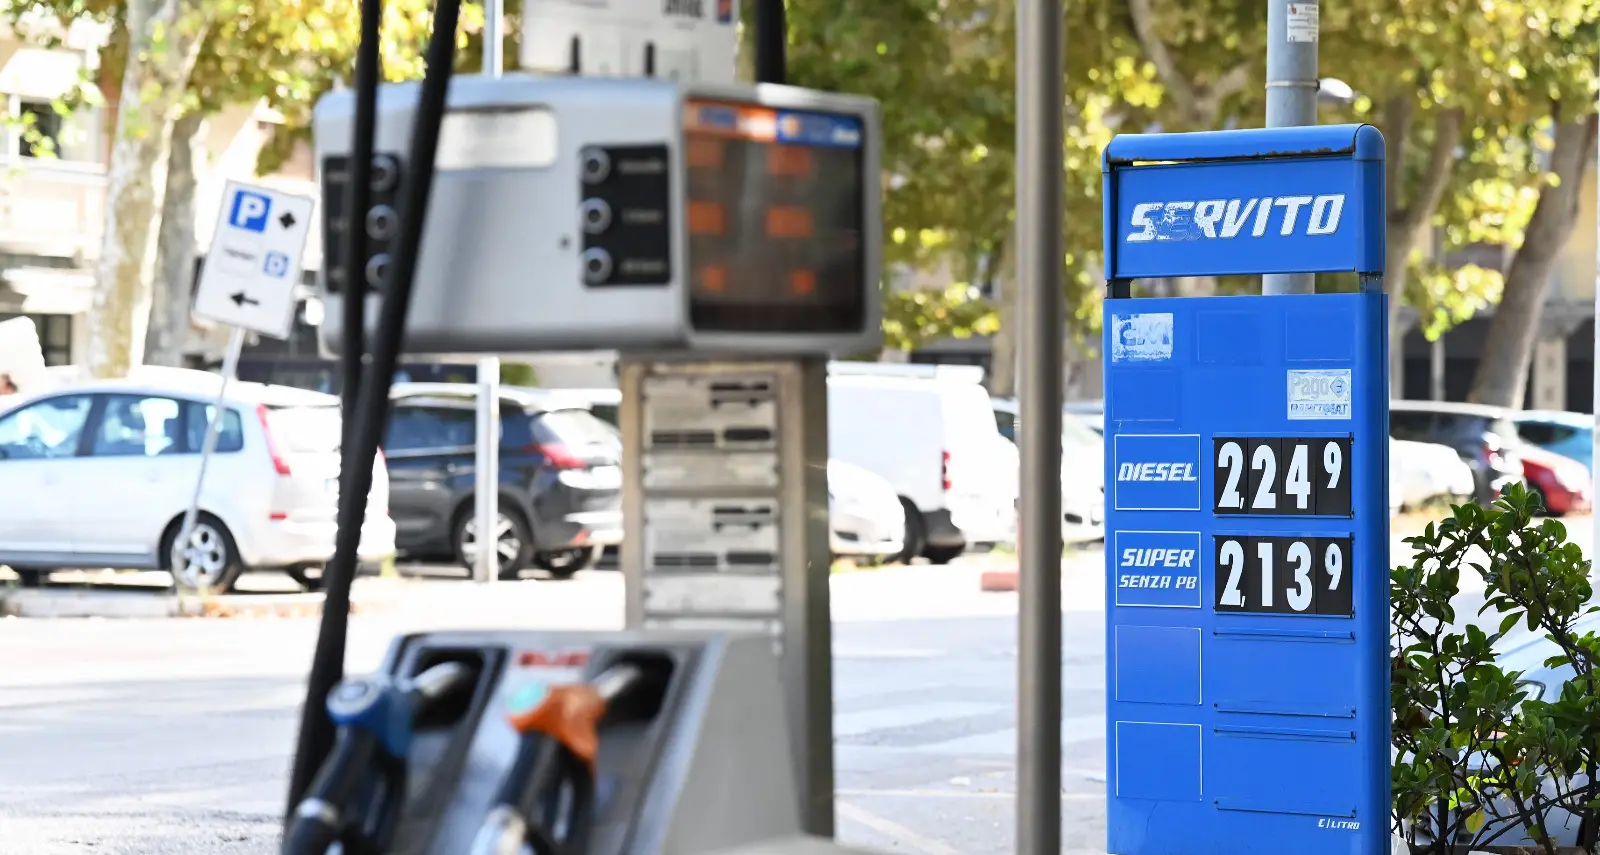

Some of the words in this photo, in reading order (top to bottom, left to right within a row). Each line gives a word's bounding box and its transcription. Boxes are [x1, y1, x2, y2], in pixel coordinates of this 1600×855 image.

[235, 193, 266, 228] P
[1118, 462, 1197, 481] DIESEL
[1121, 548, 1195, 568] SUPER
[1119, 574, 1171, 589] SENZA
[1175, 576, 1198, 590] PB
